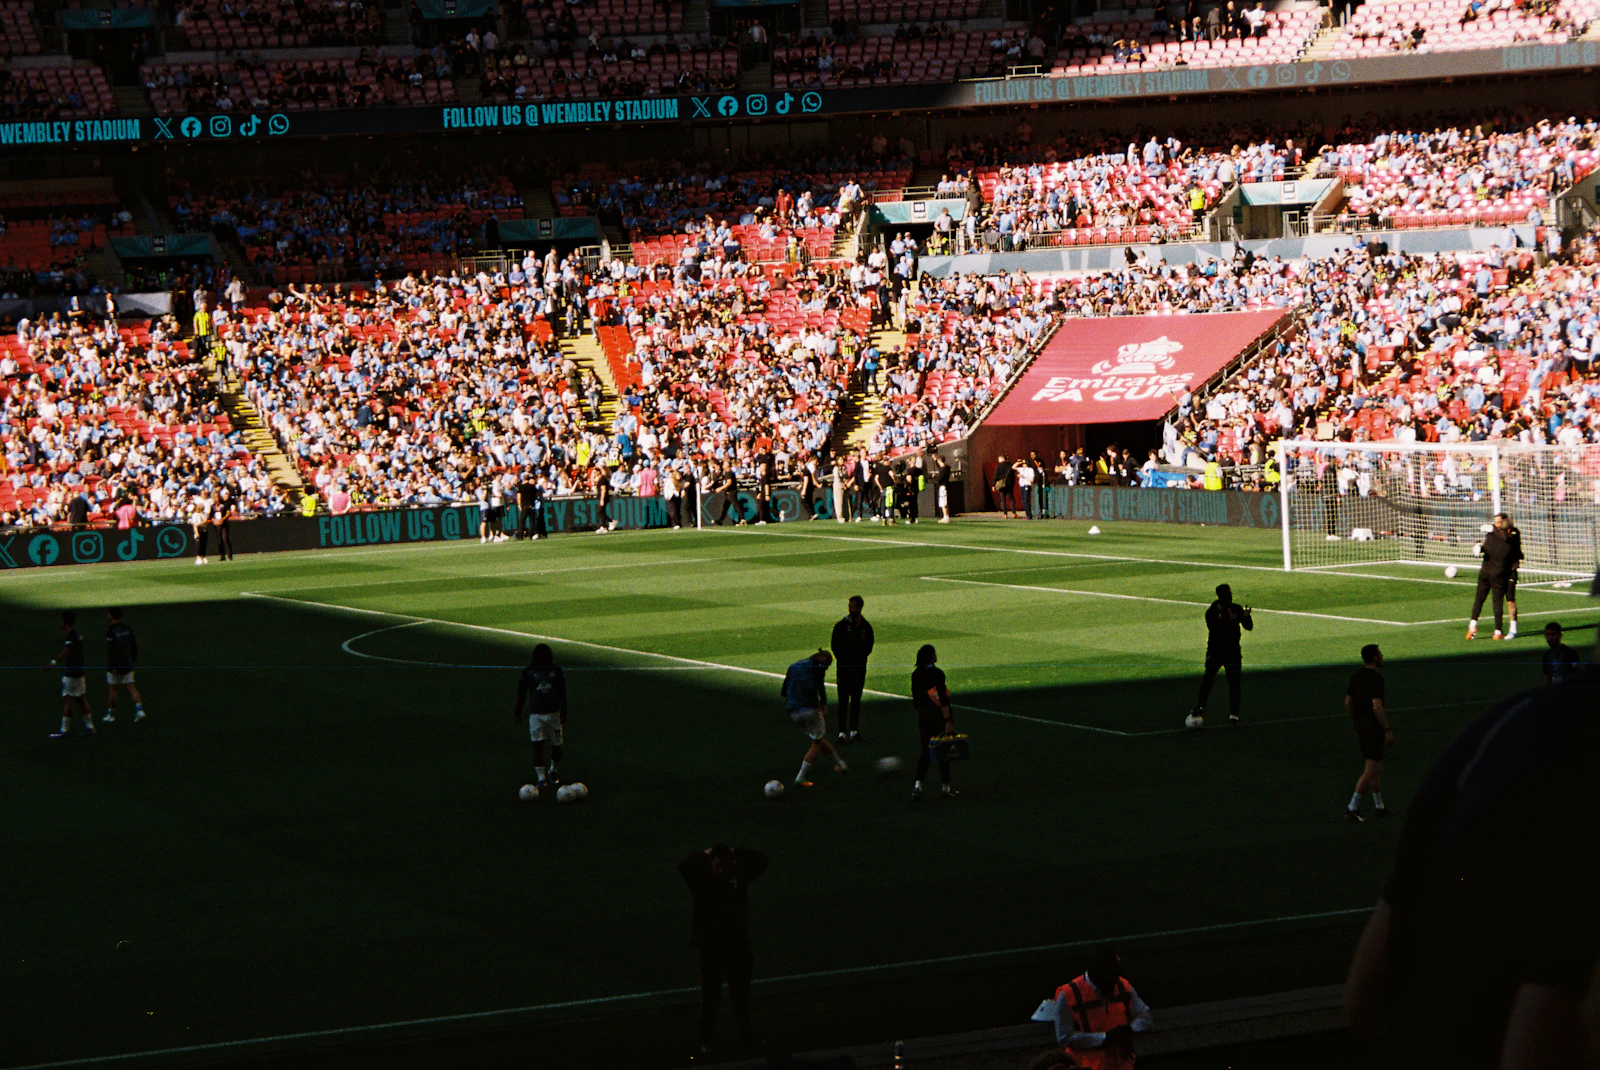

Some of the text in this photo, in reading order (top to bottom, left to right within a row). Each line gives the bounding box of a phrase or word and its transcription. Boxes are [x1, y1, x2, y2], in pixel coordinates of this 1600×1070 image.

[974, 69, 1209, 102] FOLLOW US @ WEMBLEY STADIUM
[442, 97, 679, 129] FOLLOW US @ WEMBLEY STADIUM
[0, 118, 141, 145] WEMBLEY STADIUM
[1031, 382, 1187, 402] FA CUP
[1045, 372, 1195, 389] Emirates
[1073, 487, 1094, 518] US
[1099, 487, 1114, 521] @
[1116, 488, 1175, 521] WEMBLEY
[1177, 491, 1228, 524] STADIUM
[319, 511, 400, 547] FOLLOW
[407, 509, 435, 540] US
[441, 508, 460, 540] @
